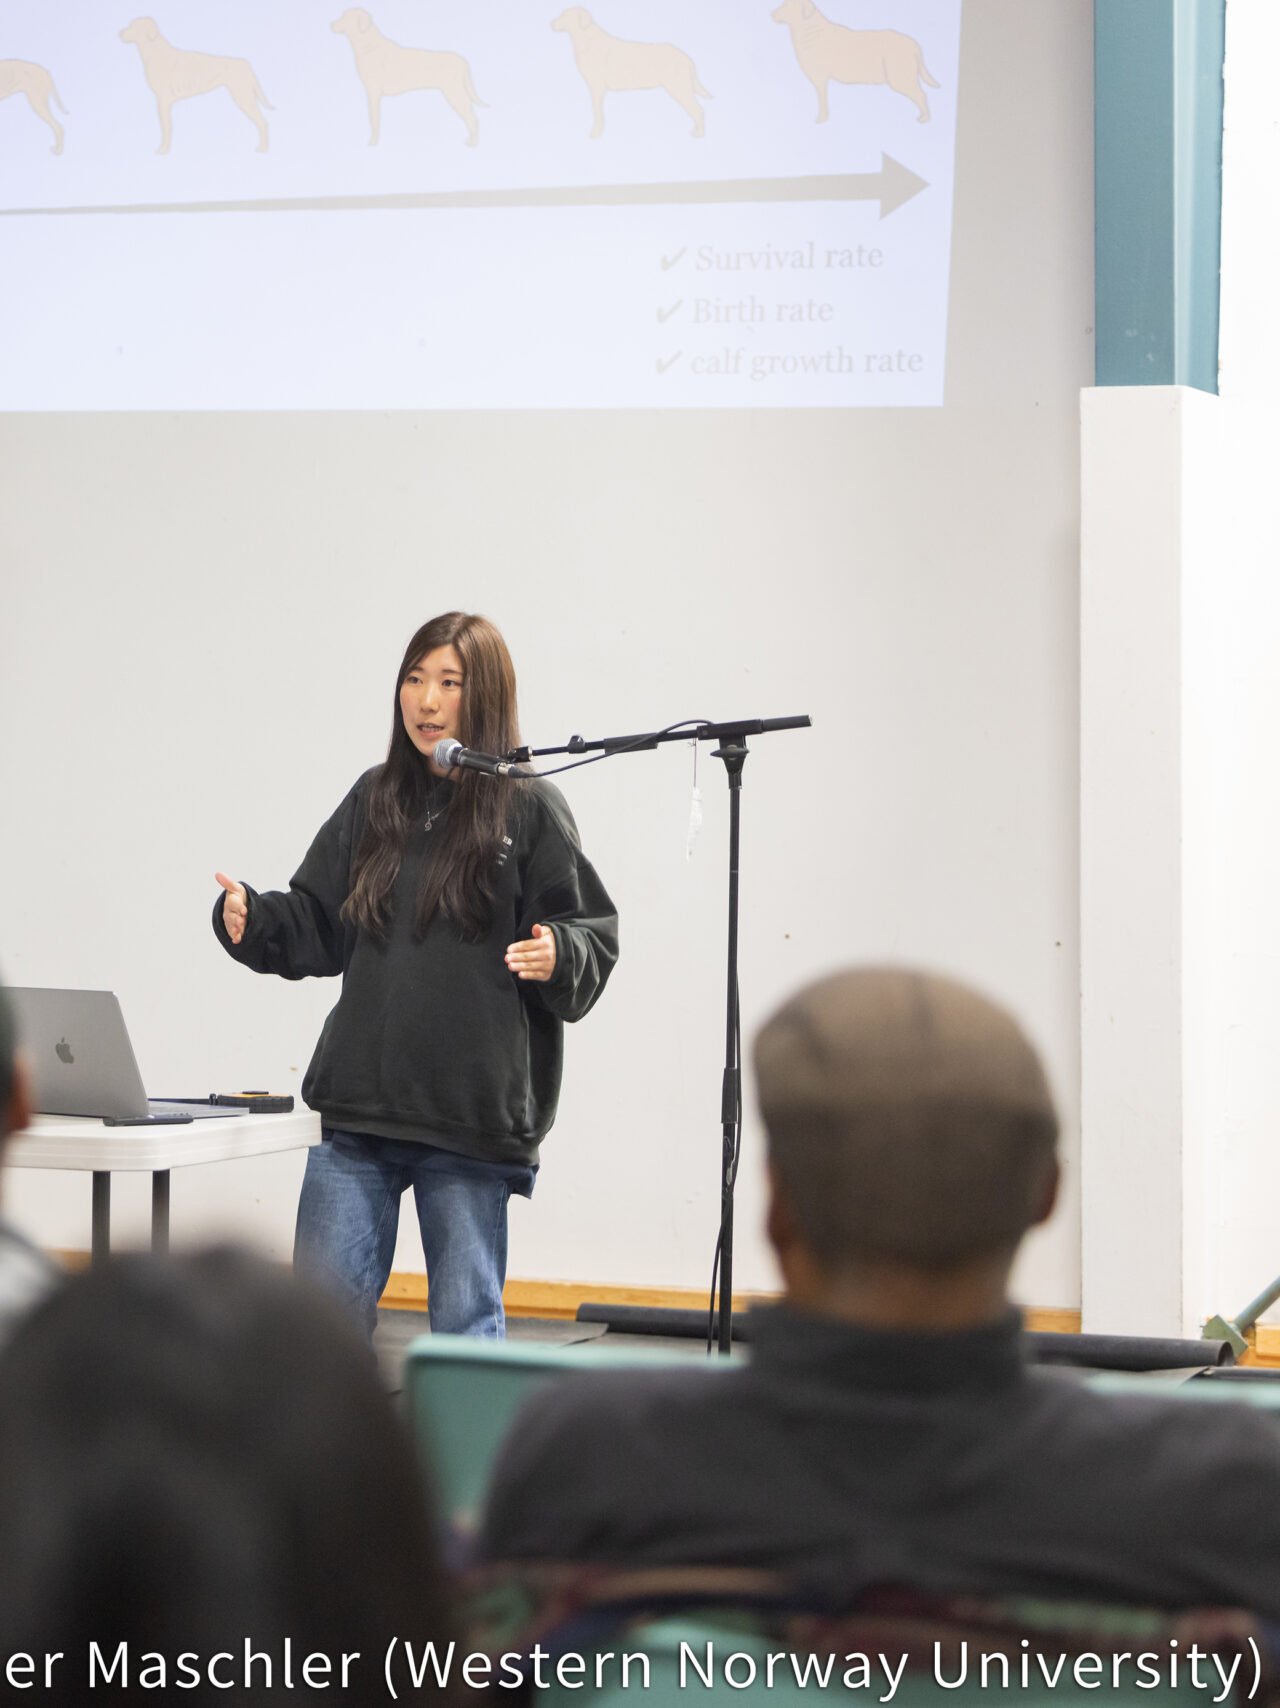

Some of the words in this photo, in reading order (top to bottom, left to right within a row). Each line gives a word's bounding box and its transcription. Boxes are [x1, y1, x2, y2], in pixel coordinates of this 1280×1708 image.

[694, 241, 815, 271] Survival
[825, 244, 884, 268] rate
[692, 296, 765, 324] Birth
[776, 299, 834, 322] rate
[690, 347, 744, 375] calf
[751, 346, 854, 381] growth
[864, 349, 924, 373] rate
